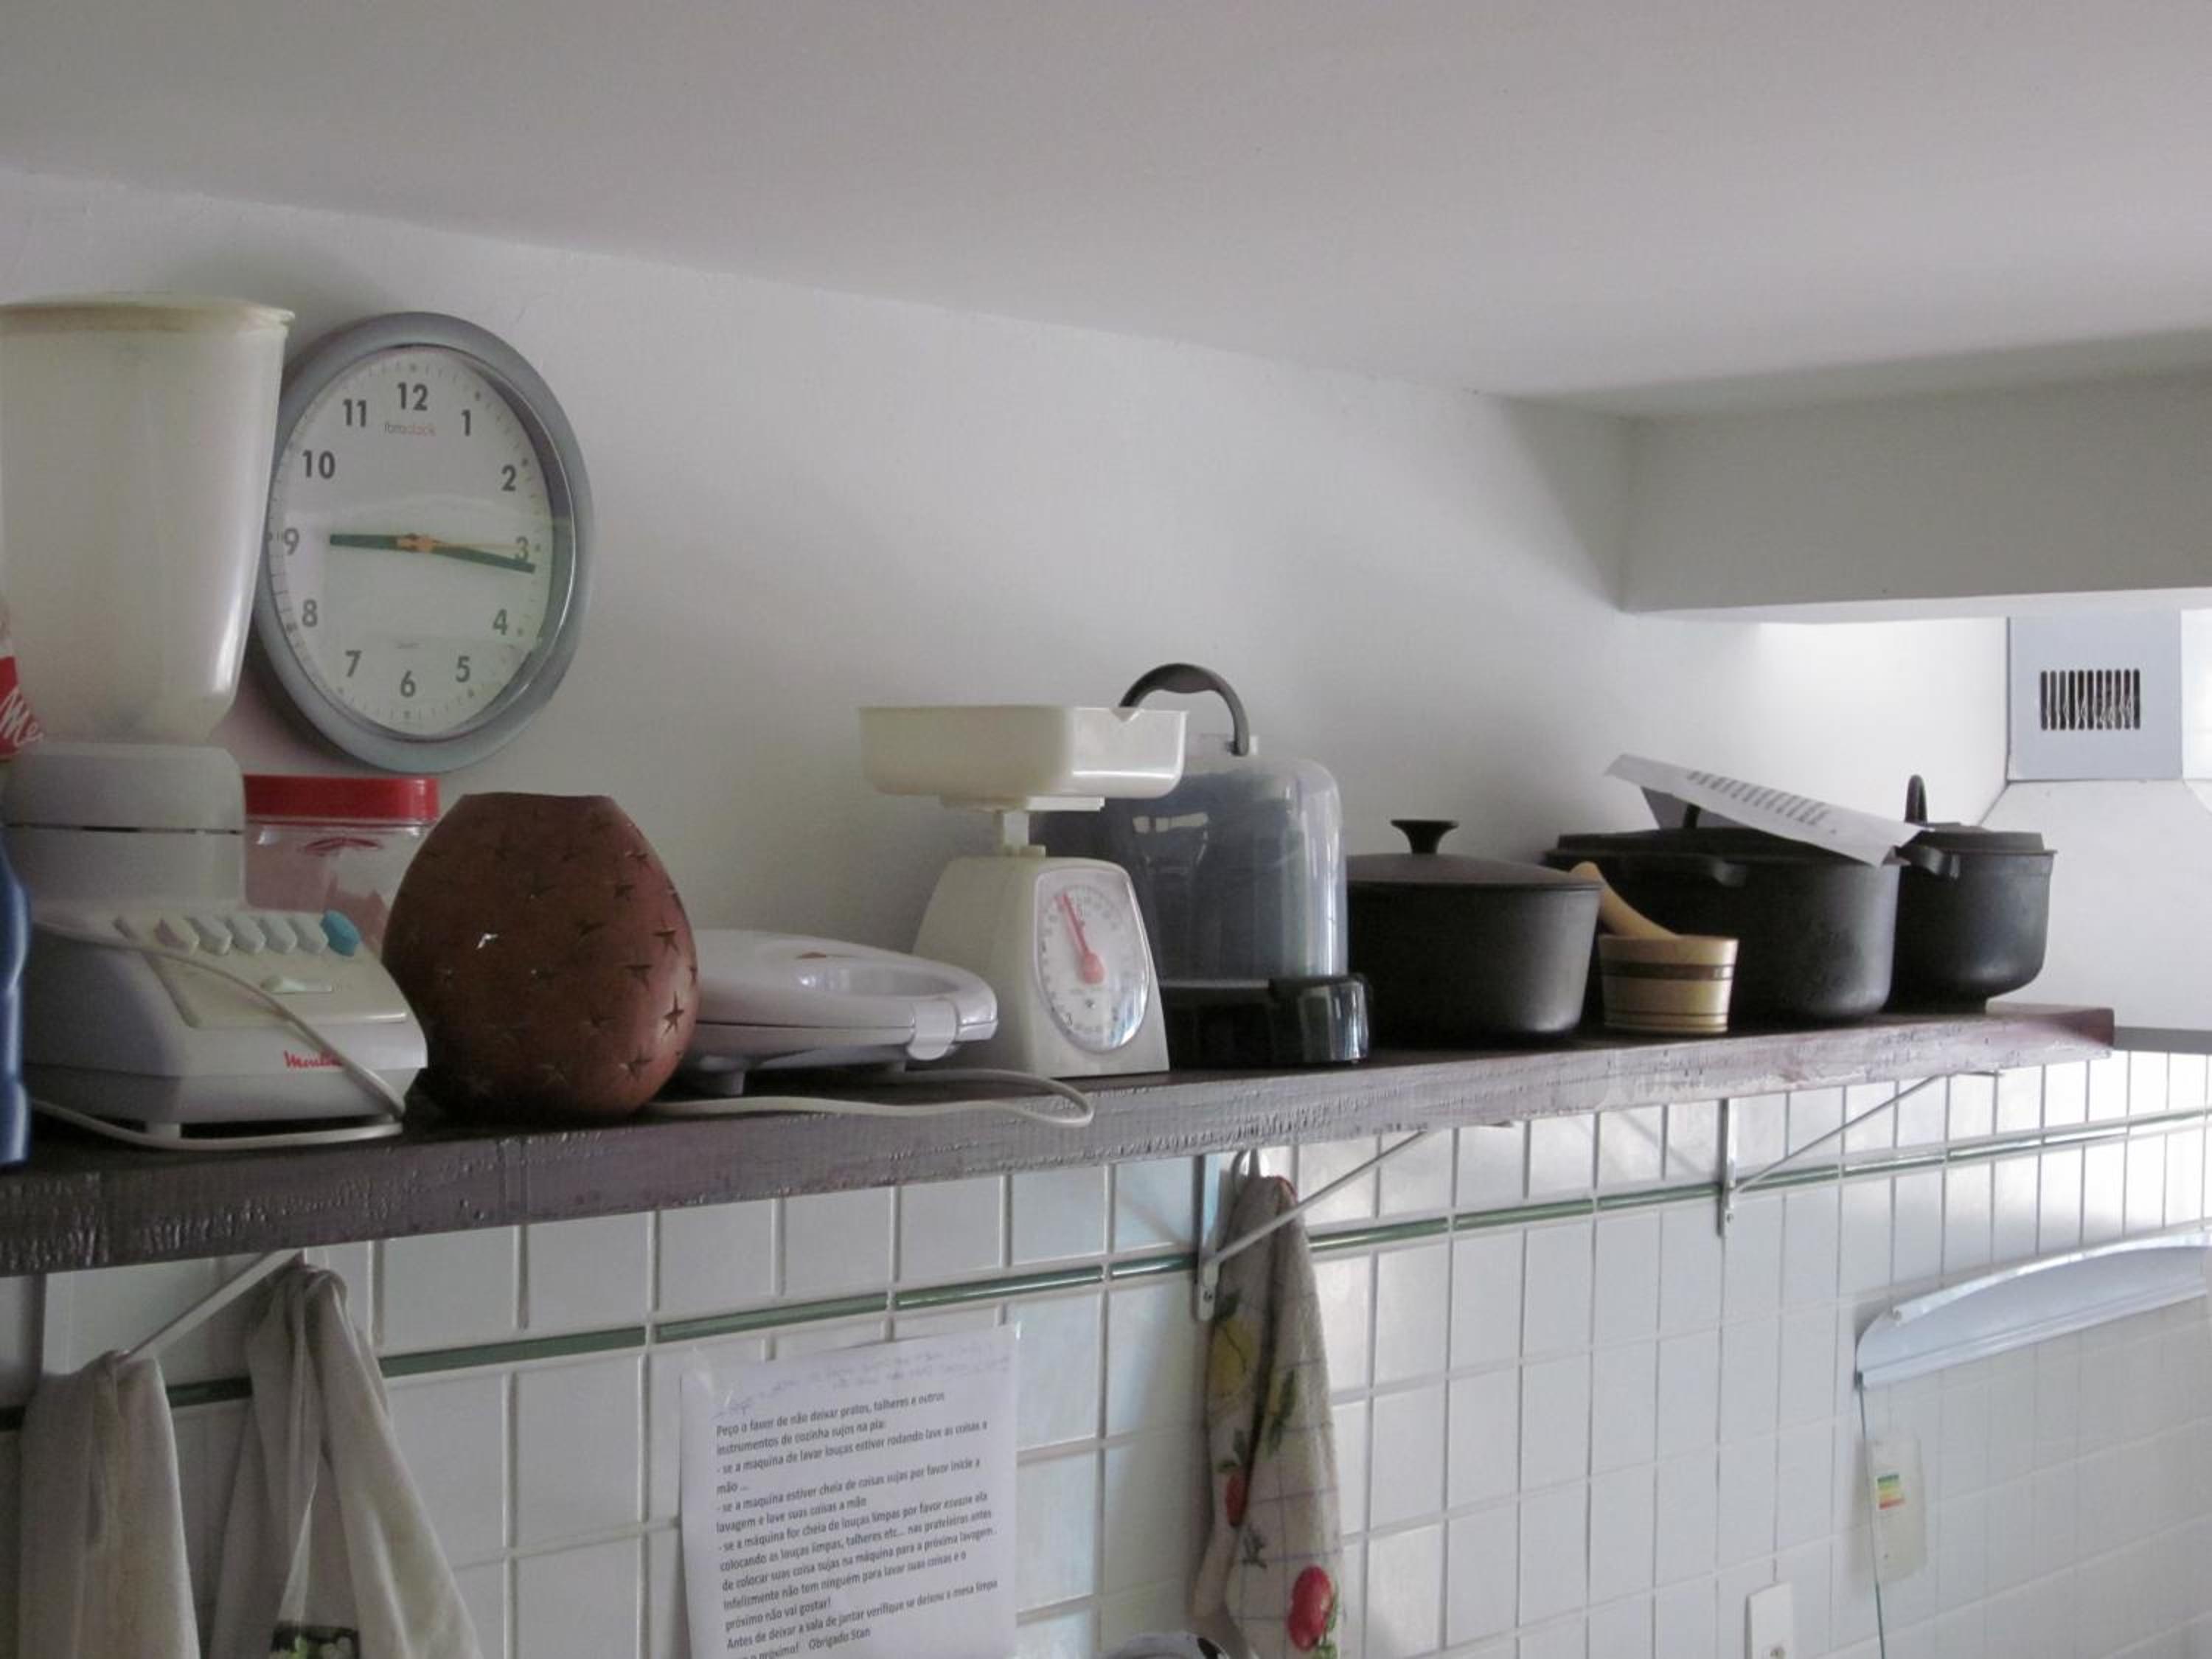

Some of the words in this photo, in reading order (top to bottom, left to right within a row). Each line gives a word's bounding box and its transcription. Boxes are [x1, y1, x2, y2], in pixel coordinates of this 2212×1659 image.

[398, 383, 428, 411] 12
[343, 399, 366, 427] 11
[462, 409, 471, 437] 1
[302, 451, 335, 479] 10
[502, 465, 516, 491] 2
[284, 528, 300, 555] 9
[515, 536, 529, 562] 3
[302, 600, 318, 627] 8
[493, 610, 508, 636] 4
[346, 650, 362, 678] 7
[456, 656, 470, 683] 5
[400, 670, 416, 698] 6
[716, 1424, 739, 1436] Peço
[742, 1423, 747, 1431] o
[750, 1419, 773, 1430] favor
[776, 1414, 788, 1426] de
[790, 1411, 809, 1424] não
[811, 1408, 839, 1420] deixar
[840, 1403, 872, 1418] pratos,
[873, 1397, 909, 1411] talheres
[911, 1396, 917, 1405] e
[717, 1437, 779, 1455] instrumentos
[781, 1433, 793, 1444] de
[794, 1427, 830, 1442] cozinha
[831, 1423, 855, 1437] sujos
[855, 1423, 868, 1433] na
[723, 1464, 732, 1473] se
[736, 1463, 742, 1471] a
[785, 1451, 798, 1463] de
[800, 1449, 824, 1461] lavar
[855, 1439, 885, 1451] estiver
[887, 1430, 924, 1446] rodando
[925, 1427, 942, 1439] lave
[944, 1427, 953, 1436] as
[956, 1422, 980, 1434] coisas
[716, 1480, 738, 1493] mão
[722, 1502, 732, 1512] se
[735, 1500, 742, 1509] a
[786, 1487, 817, 1500] estiver
[819, 1481, 843, 1495] cheia
[845, 1478, 856, 1490] de
[858, 1475, 886, 1487] coisas
[887, 1470, 909, 1484] sujas
[910, 1468, 924, 1481] por
[926, 1464, 949, 1475] favor
[950, 1458, 973, 1471] inicie
[975, 1458, 980, 1467] a
[716, 1517, 757, 1532] lavagem
[759, 1516, 764, 1525] e
[766, 1512, 785, 1523] lave
[787, 1508, 808, 1520] suas
[810, 1503, 837, 1515] coisas
[838, 1501, 845, 1510] a
[846, 1495, 867, 1509] mão
[723, 1541, 734, 1551] se
[737, 1540, 742, 1548] a
[786, 1527, 801, 1539] for
[802, 1523, 827, 1536] cheia
[827, 1519, 840, 1531] de
[872, 1509, 900, 1523] limpas
[902, 1506, 917, 1519] por
[919, 1501, 942, 1513] favor
[720, 1552, 768, 1571] colocando
[768, 1552, 779, 1562] as
[811, 1539, 844, 1554] limpas,
[846, 1531, 883, 1546] talheres
[908, 1523, 922, 1534] nas
[970, 1510, 992, 1522] antes
[722, 1578, 734, 1590] de
[736, 1573, 768, 1587] colocar
[771, 1568, 791, 1580] suas
[793, 1563, 815, 1576] coisa
[817, 1557, 840, 1571] sujas
[842, 1555, 855, 1565] na
[895, 1543, 915, 1557] para
[917, 1541, 922, 1550] a
[782, 1583, 799, 1596] não
[801, 1581, 819, 1593] tem
[862, 1568, 883, 1582] para
[884, 1563, 906, 1576] lavar
[907, 1559, 925, 1571] suas
[927, 1554, 952, 1567] coisas
[953, 1552, 959, 1561] e
[960, 1551, 967, 1559] o
[765, 1607, 782, 1620] não
[784, 1604, 797, 1616] vai
[799, 1596, 832, 1615] gostar!
[727, 1635, 754, 1648] Antes
[755, 1630, 767, 1642] de
[768, 1625, 797, 1639] deixar
[805, 1616, 824, 1630] sala
[826, 1613, 838, 1626] de
[838, 1610, 863, 1626] jantar
[866, 1600, 905, 1616] verifique
[906, 1598, 915, 1607] se
[850, 1628, 872, 1640] Stan
